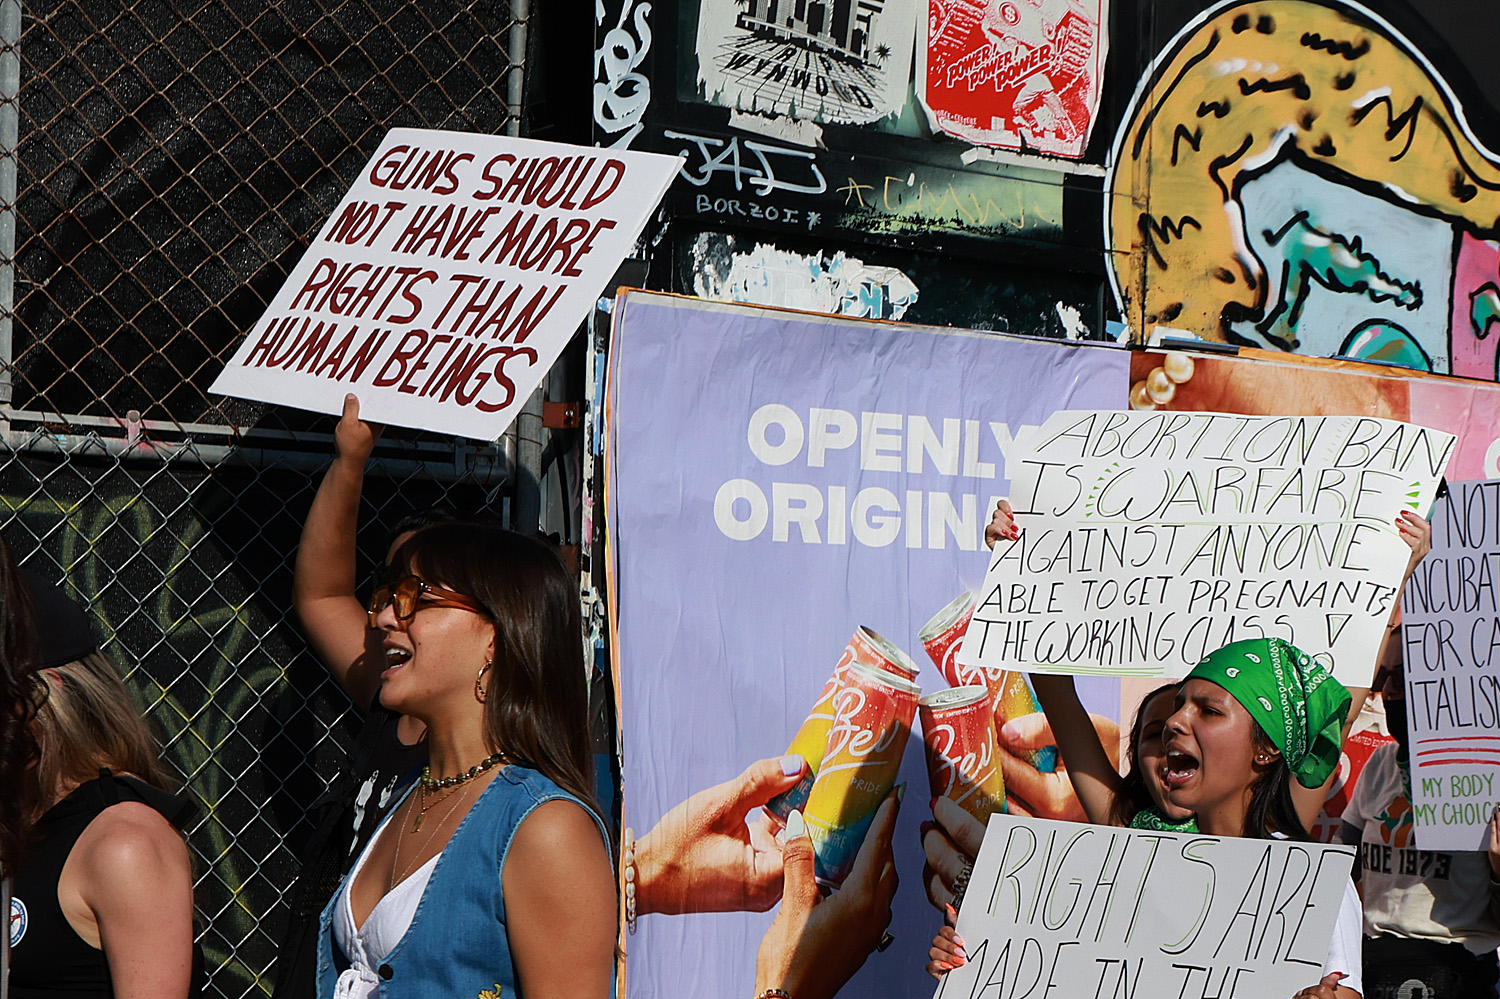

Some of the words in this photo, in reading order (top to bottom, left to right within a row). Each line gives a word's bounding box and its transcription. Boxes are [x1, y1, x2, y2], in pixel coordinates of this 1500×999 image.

[946, 43, 998, 88] POWER!
[967, 46, 1020, 92] POWER!
[369, 145, 475, 196] GUNS
[472, 153, 627, 211] SHOULD
[324, 200, 406, 246] NOT
[406, 203, 500, 262] HAVE
[480, 214, 617, 278] MORE
[297, 258, 439, 325] RIGHTS
[434, 274, 567, 343] THAN
[242, 318, 392, 383] HUMAN
[374, 329, 539, 413] BEINGS
[747, 403, 1042, 481] OPENLY
[1036, 413, 1327, 466] ABORTION
[1334, 418, 1458, 479] BAN
[713, 478, 1009, 552] ORIGIN
[1011, 460, 1083, 517] IS
[1095, 465, 1397, 525] WARFARE
[989, 525, 1185, 576] AGAINST
[1181, 524, 1381, 577] ANYONE
[977, 582, 1064, 616] ABLE
[1082, 580, 1119, 610] TO
[1121, 575, 1172, 607] GET
[1188, 579, 1388, 613] PREGNANT
[973, 617, 1031, 662] THE
[1033, 612, 1176, 666] WORKING
[1405, 617, 1463, 673] FOR
[817, 687, 901, 775] Bev
[850, 776, 882, 795] PRIDE
[974, 790, 1001, 809] PRIDE
[1422, 777, 1444, 799] MY
[1450, 772, 1495, 799] BODY
[1414, 806, 1439, 827] MY
[1399, 850, 1453, 880] 1973
[987, 825, 1222, 955] RIGHTS
[1213, 843, 1356, 967] ARE
